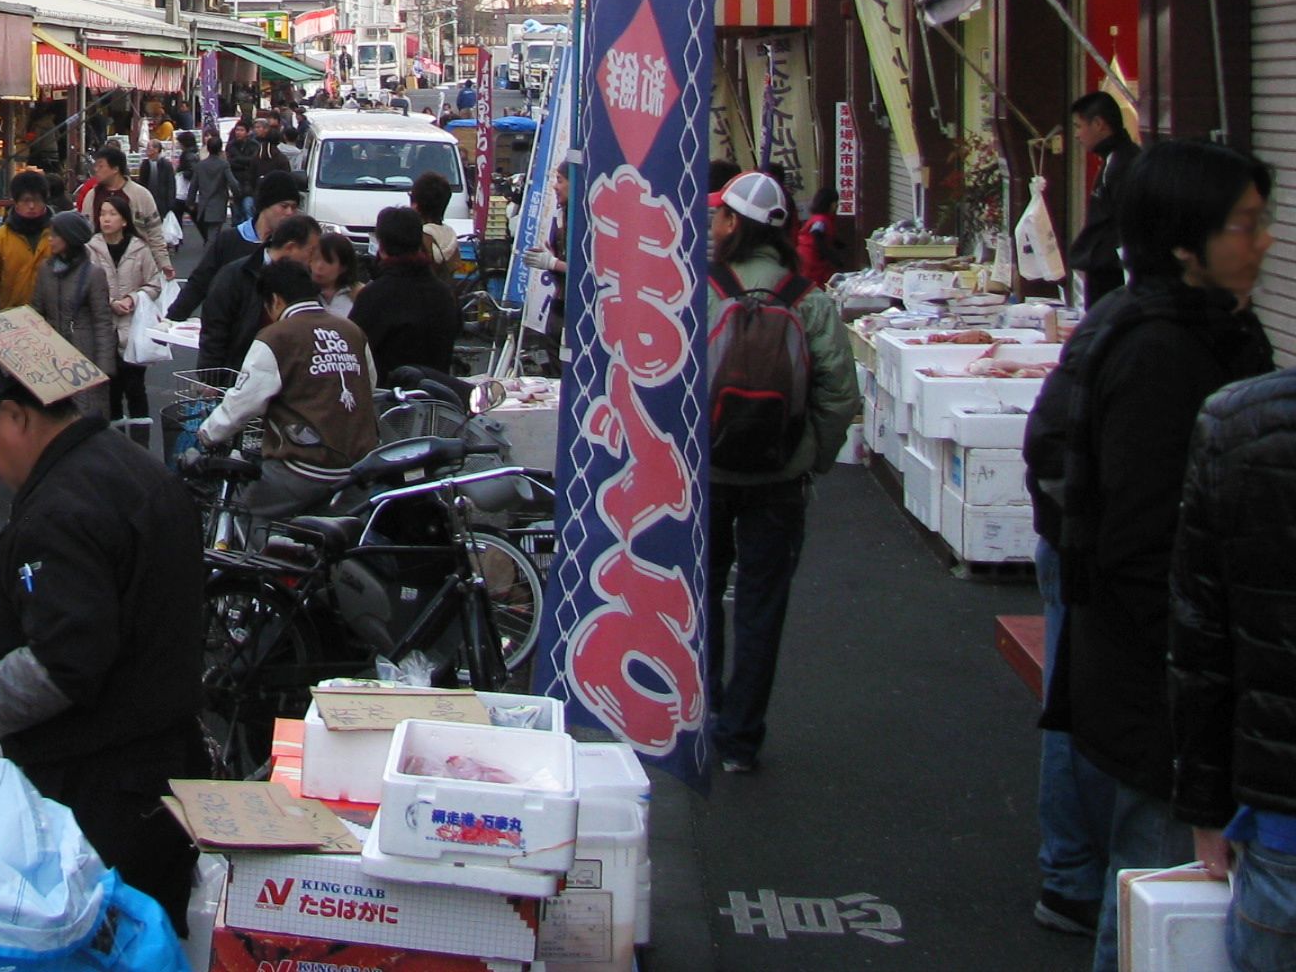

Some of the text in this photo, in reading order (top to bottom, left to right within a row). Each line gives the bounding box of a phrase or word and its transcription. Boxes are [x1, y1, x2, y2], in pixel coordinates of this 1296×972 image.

[314, 328, 340, 341] the
[314, 339, 349, 354] LRG
[302, 879, 386, 899] KING CRAB
[299, 894, 399, 924] たらばがに
